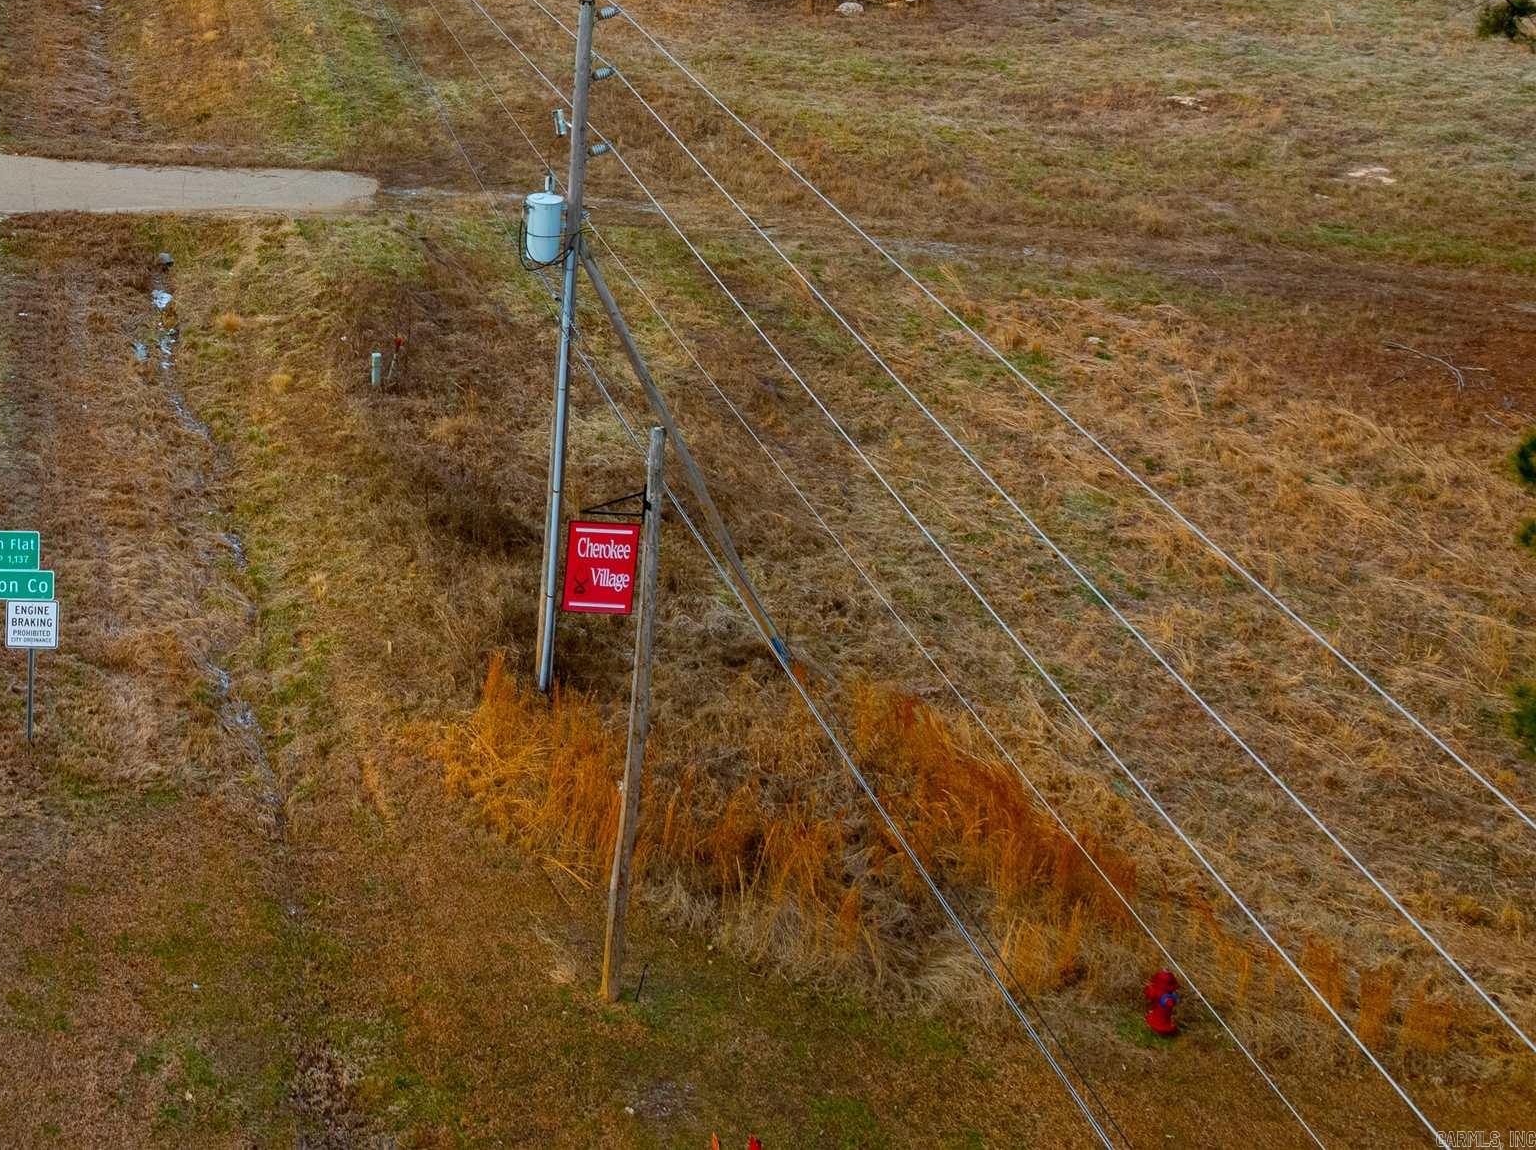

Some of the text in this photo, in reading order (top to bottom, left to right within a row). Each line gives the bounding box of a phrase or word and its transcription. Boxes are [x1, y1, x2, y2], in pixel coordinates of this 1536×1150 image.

[10, 538, 35, 551] Flat
[577, 537, 631, 560] Cherokee
[27, 578, 48, 593] Co
[590, 567, 630, 592] Village
[15, 605, 50, 616] ENGINE
[11, 617, 53, 628] BRAKING
[12, 629, 51, 637] PROHIBITED
